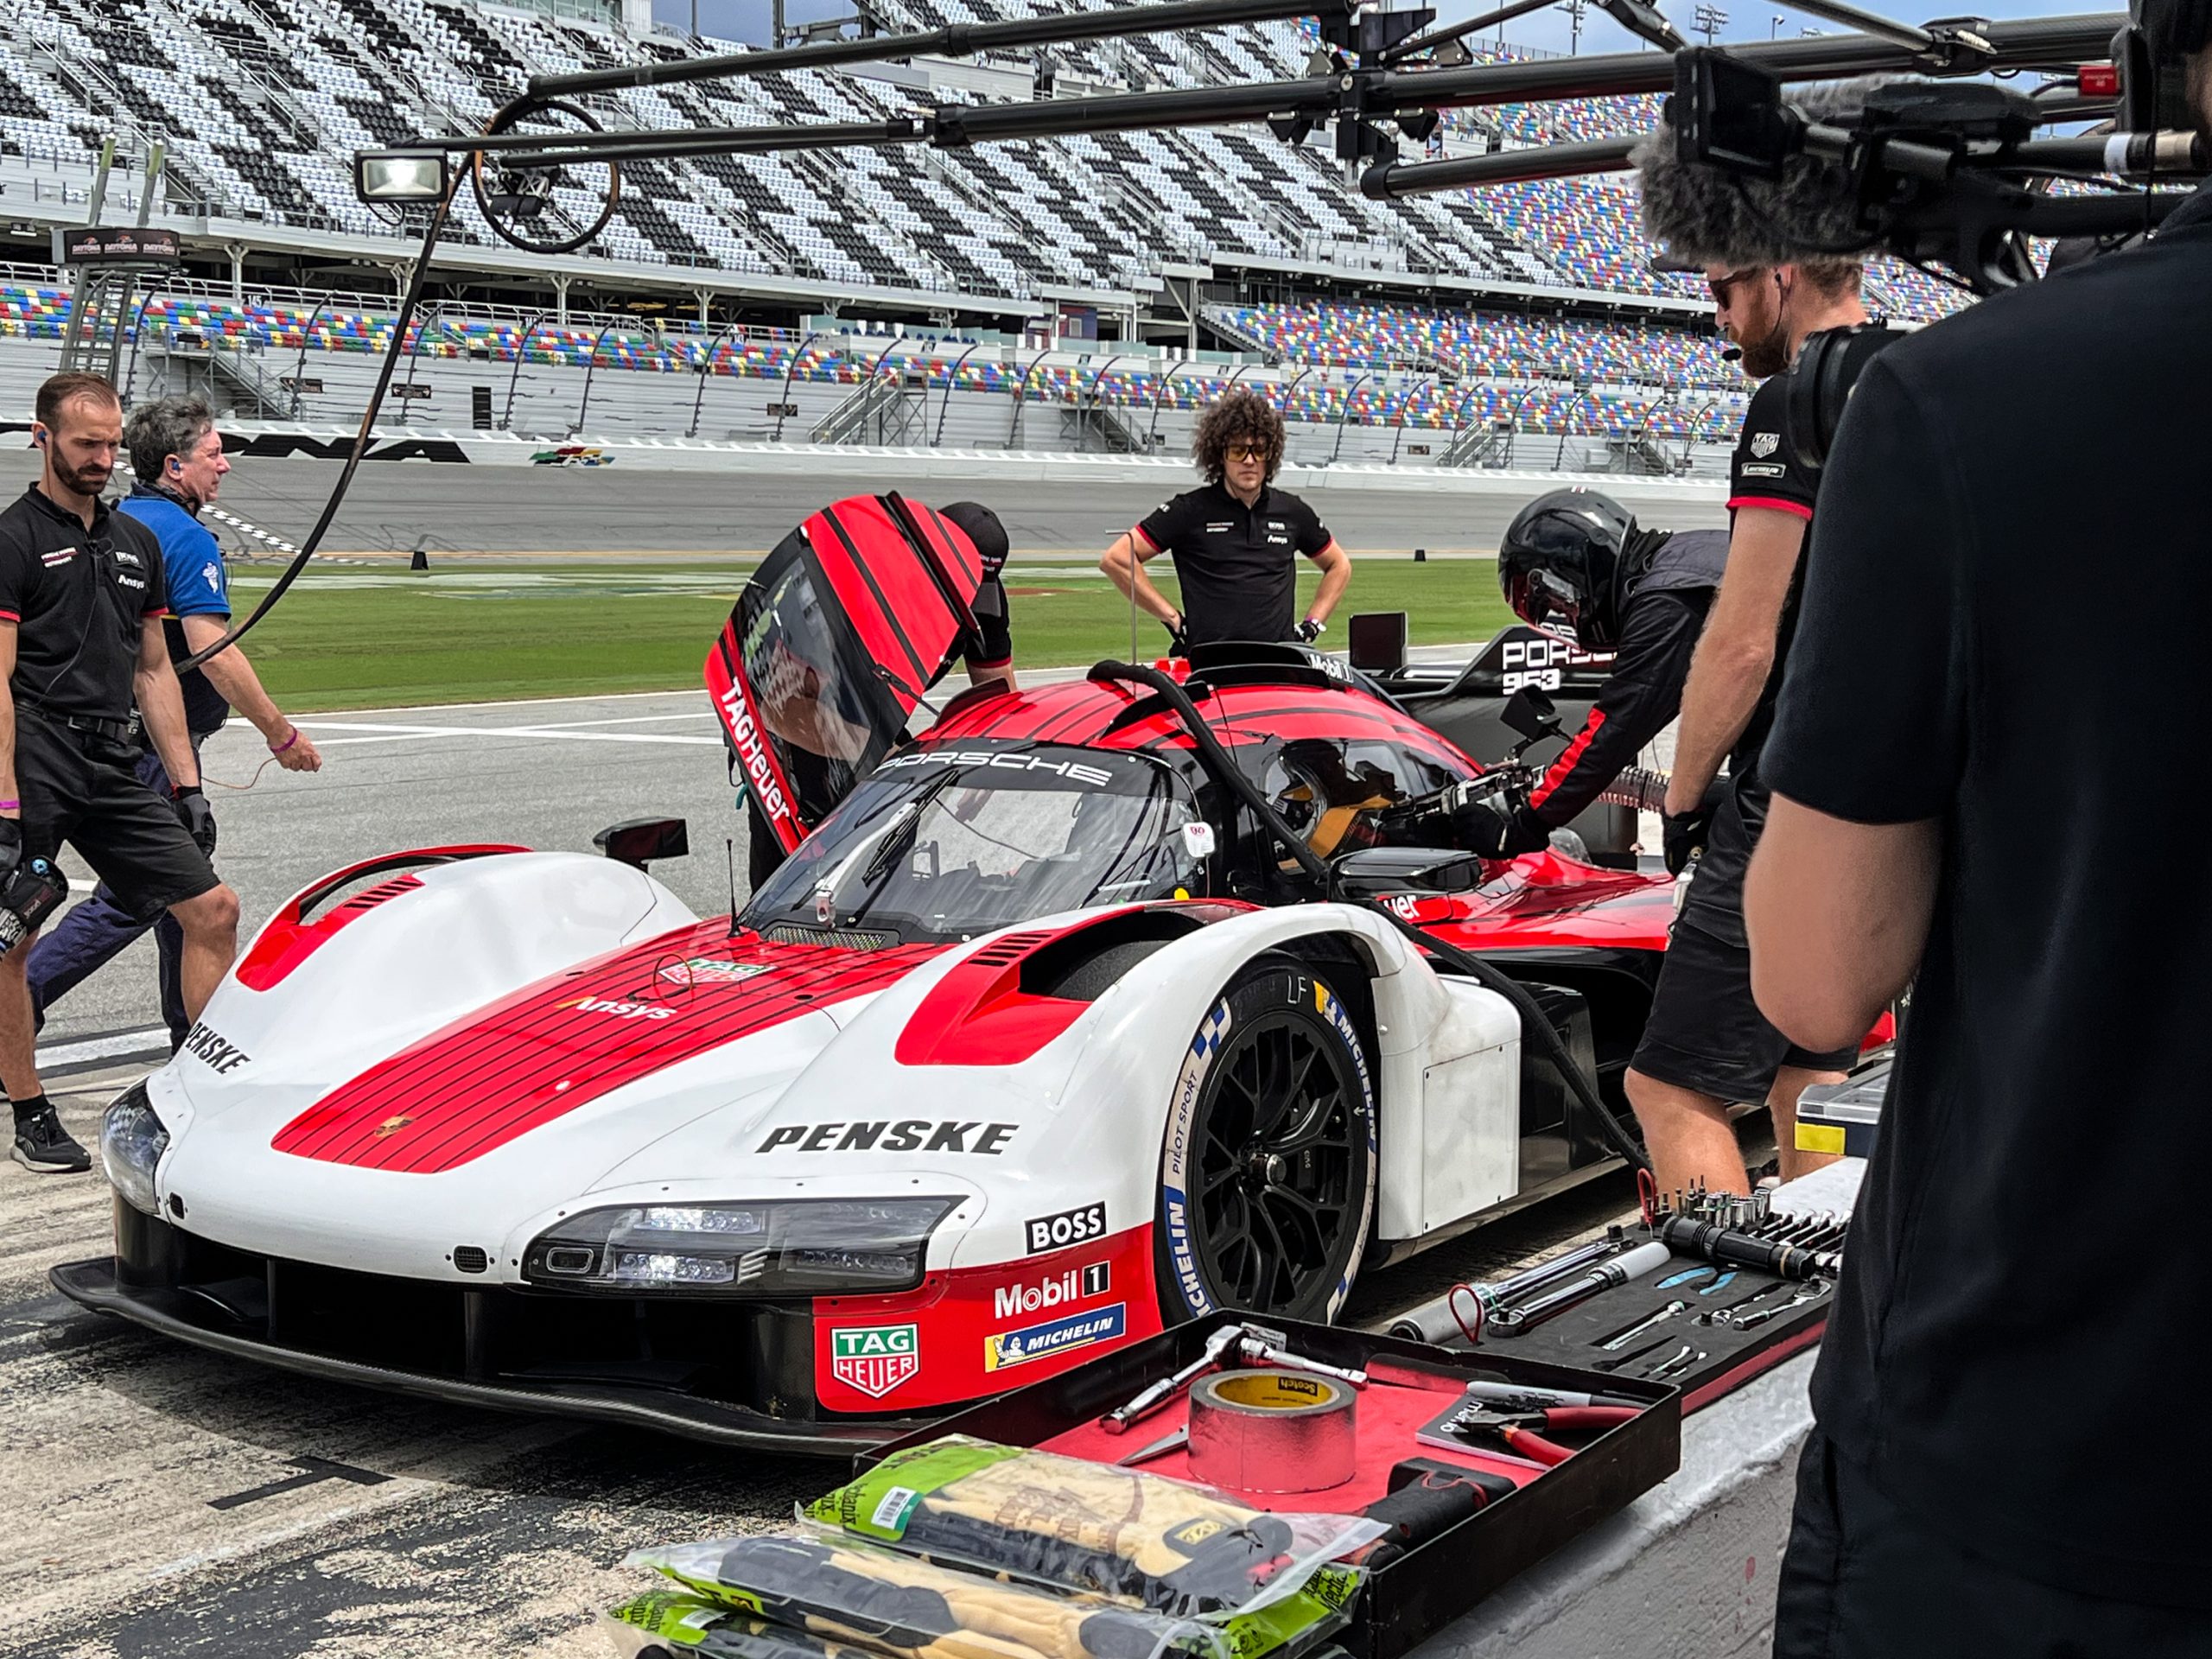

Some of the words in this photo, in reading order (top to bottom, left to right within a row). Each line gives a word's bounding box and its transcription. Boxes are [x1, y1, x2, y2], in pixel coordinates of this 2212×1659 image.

[118, 574, 145, 589] Ansys
[1309, 653, 1342, 679] Mobil
[872, 752, 1113, 787] PORSCHE
[1287, 975, 1307, 1004] LF
[556, 996, 677, 1020] Ansys
[185, 1021, 251, 1075] PENSKE
[1337, 1016, 1376, 1142] MICHELIN
[754, 1121, 1020, 1156] PENSKE
[1173, 1125, 1185, 1175] PILOT
[1179, 1070, 1198, 1123] SPORT
[1031, 1207, 1103, 1249] BOSS
[1168, 1201, 1214, 1318] ICHELIN
[995, 1269, 1077, 1319] Mobil
[839, 1331, 911, 1353] TAG
[1027, 1316, 1114, 1352] MICHELIN
[838, 1357, 914, 1391] HEUER
[1280, 1377, 1317, 1395] Scotch
